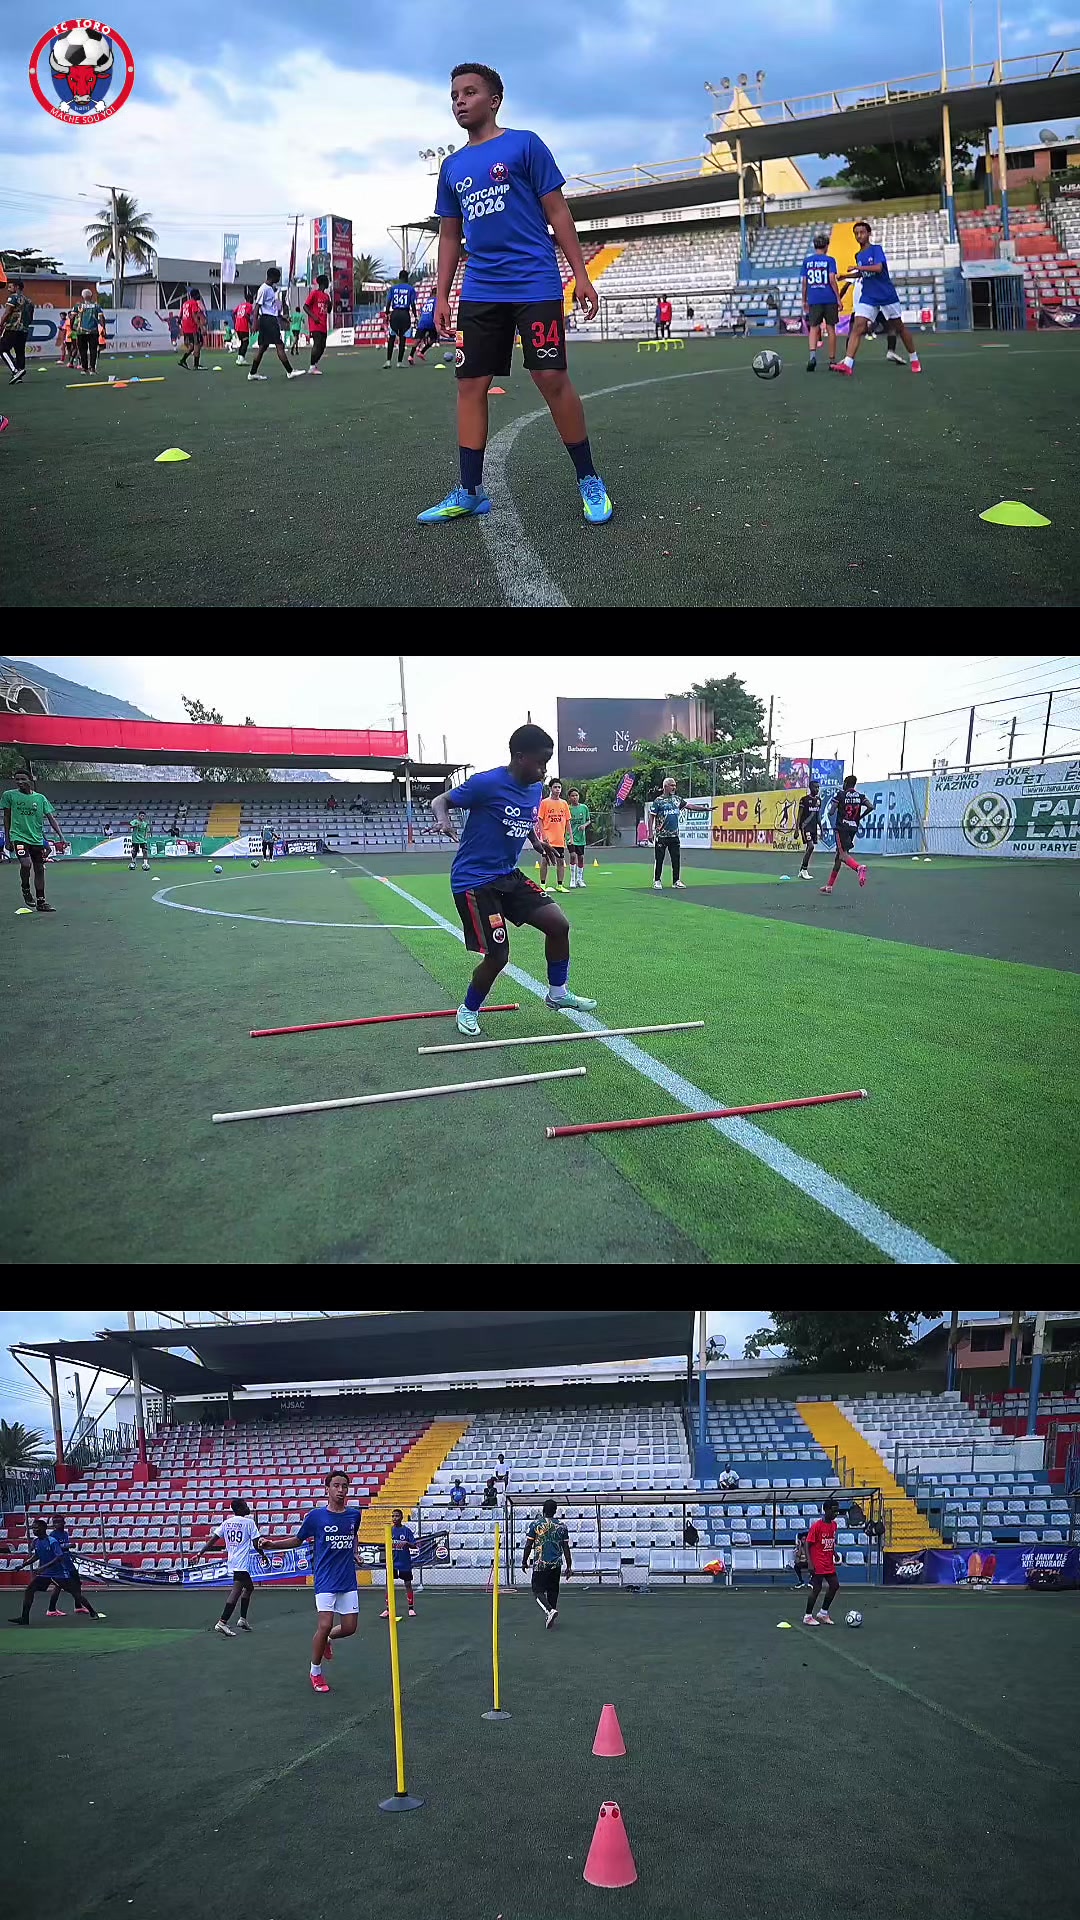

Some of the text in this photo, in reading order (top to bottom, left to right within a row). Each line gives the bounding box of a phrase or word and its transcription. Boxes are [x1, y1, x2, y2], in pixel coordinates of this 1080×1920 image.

[462, 184, 510, 208] BOOTCAMP
[467, 195, 505, 221] 2026
[807, 270, 829, 284] 391
[393, 294, 408, 304] 341
[531, 320, 560, 348] 34
[614, 730, 631, 741] Né
[612, 740, 624, 752] de
[1005, 767, 1030, 775] JWE
[935, 780, 979, 792] KAZINO
[722, 800, 748, 822] FC
[1013, 843, 1077, 851] NOU PARYE
[280, 1400, 305, 1409] MJSAC
[331, 1540, 353, 1549] 2026
[896, 1562, 924, 1576] PRO
